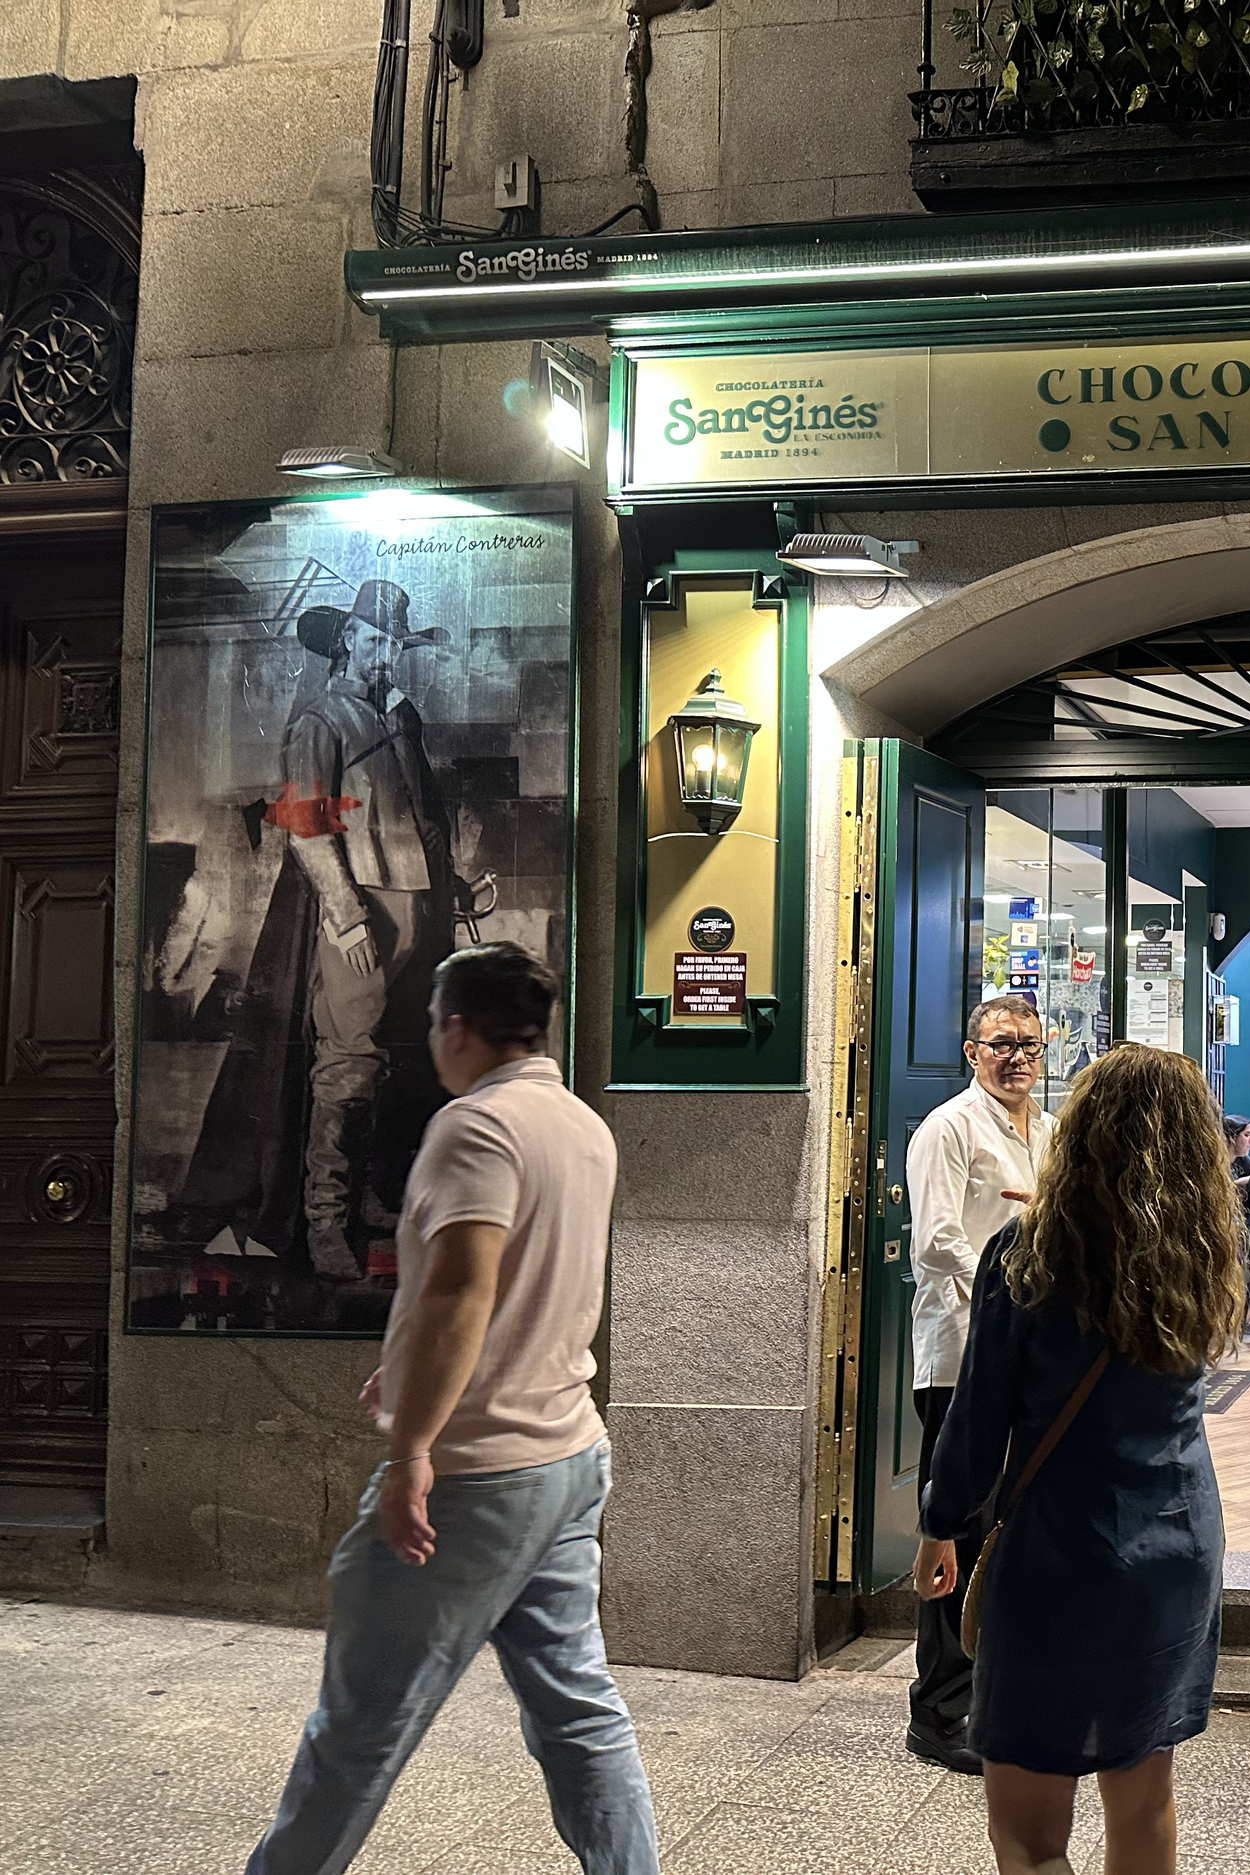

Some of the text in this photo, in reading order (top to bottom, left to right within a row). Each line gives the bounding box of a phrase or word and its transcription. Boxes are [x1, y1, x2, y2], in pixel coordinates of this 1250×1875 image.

[384, 264, 451, 275] CHOCOLATERÍA
[596, 254, 633, 263] MADRID
[637, 253, 658, 261] 1894
[715, 377, 824, 392] CHOCOLATERÍA
[793, 431, 883, 442] LA ESCONDIDA
[1105, 409, 1232, 453] SAN
[720, 448, 819, 459] MADRID 1894
[376, 534, 546, 560] Capitán Contreras
